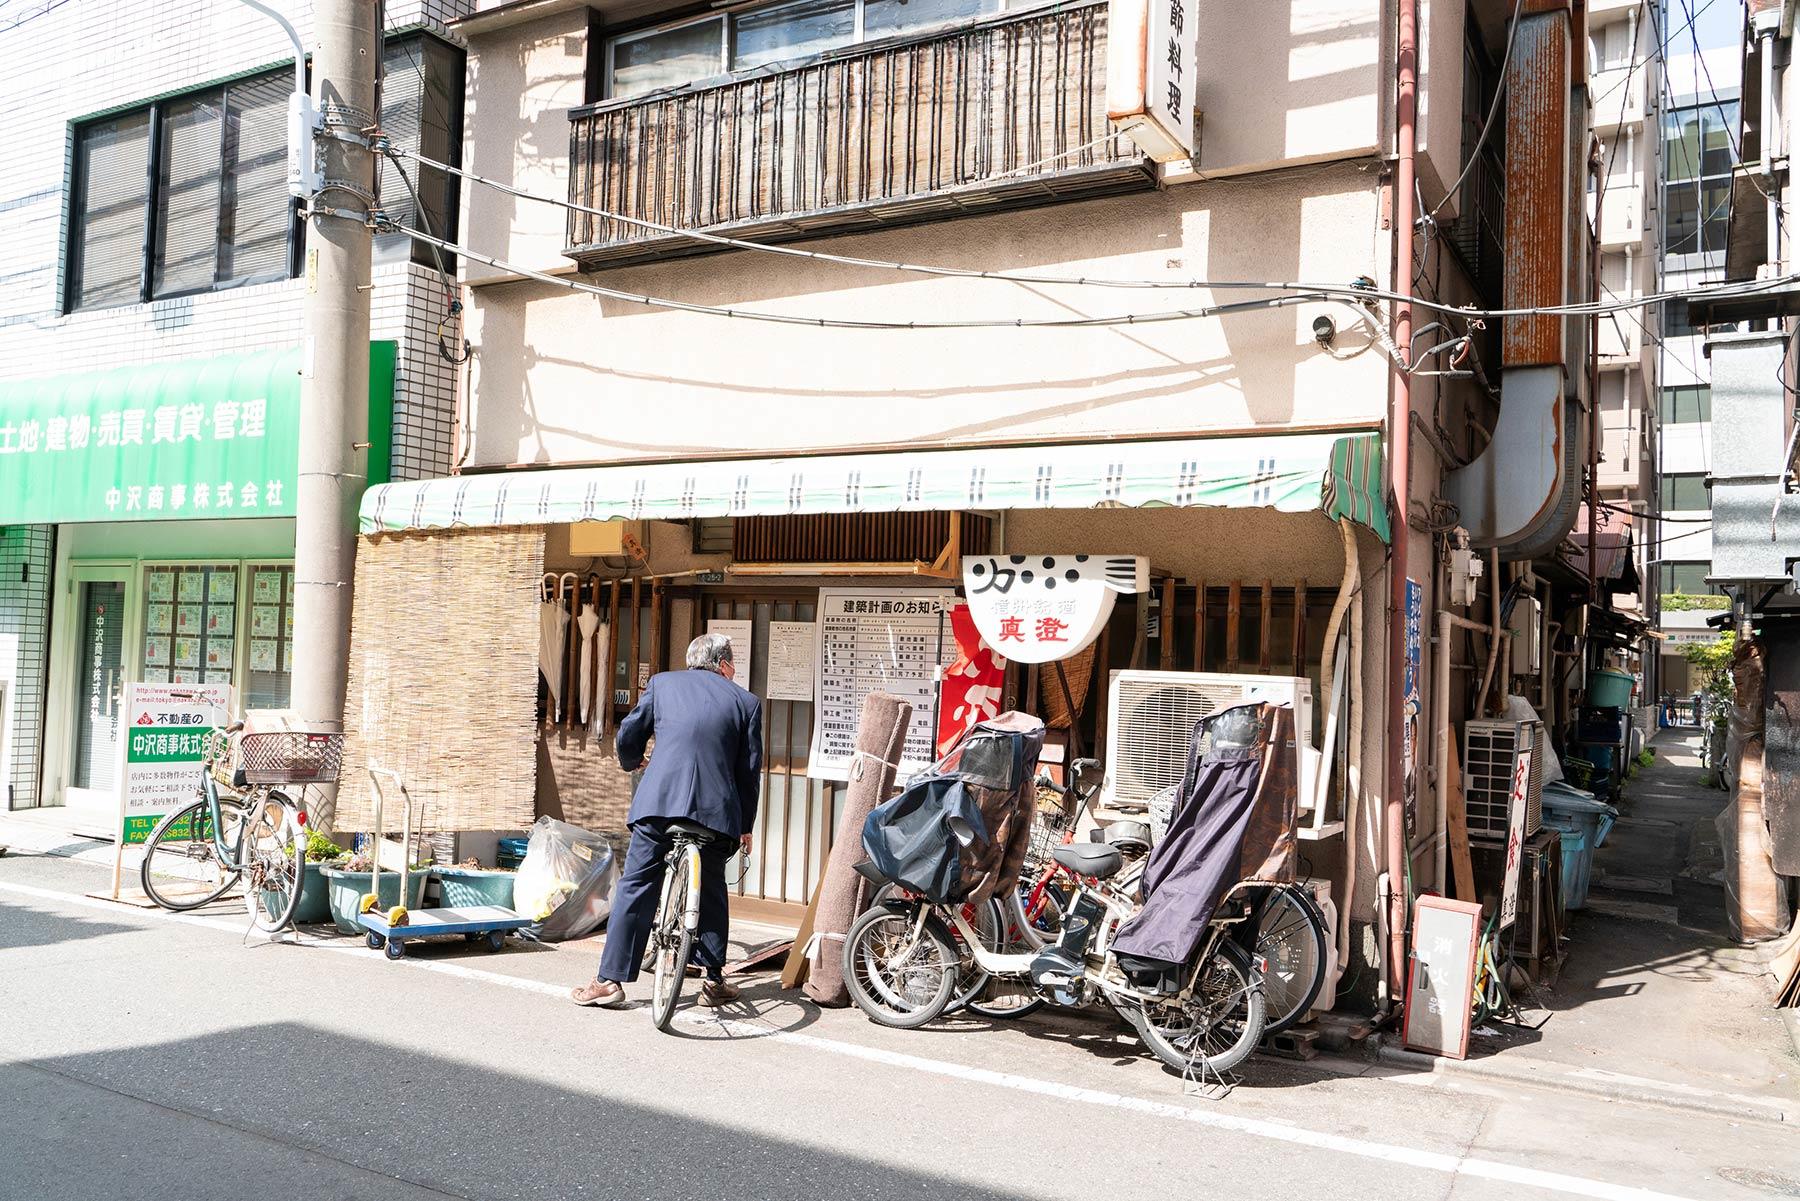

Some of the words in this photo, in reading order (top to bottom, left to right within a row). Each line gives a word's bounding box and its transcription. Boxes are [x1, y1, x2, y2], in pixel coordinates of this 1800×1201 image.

[105, 479, 284, 512] 中沢商事株式会社
[843, 600, 952, 614] 建築計画のお知ら
[999, 616, 1069, 643] 真澄
[89, 615, 105, 722] 中沢商事株式会社
[157, 713, 204, 725] 不動産の
[131, 818, 150, 828] TEL
